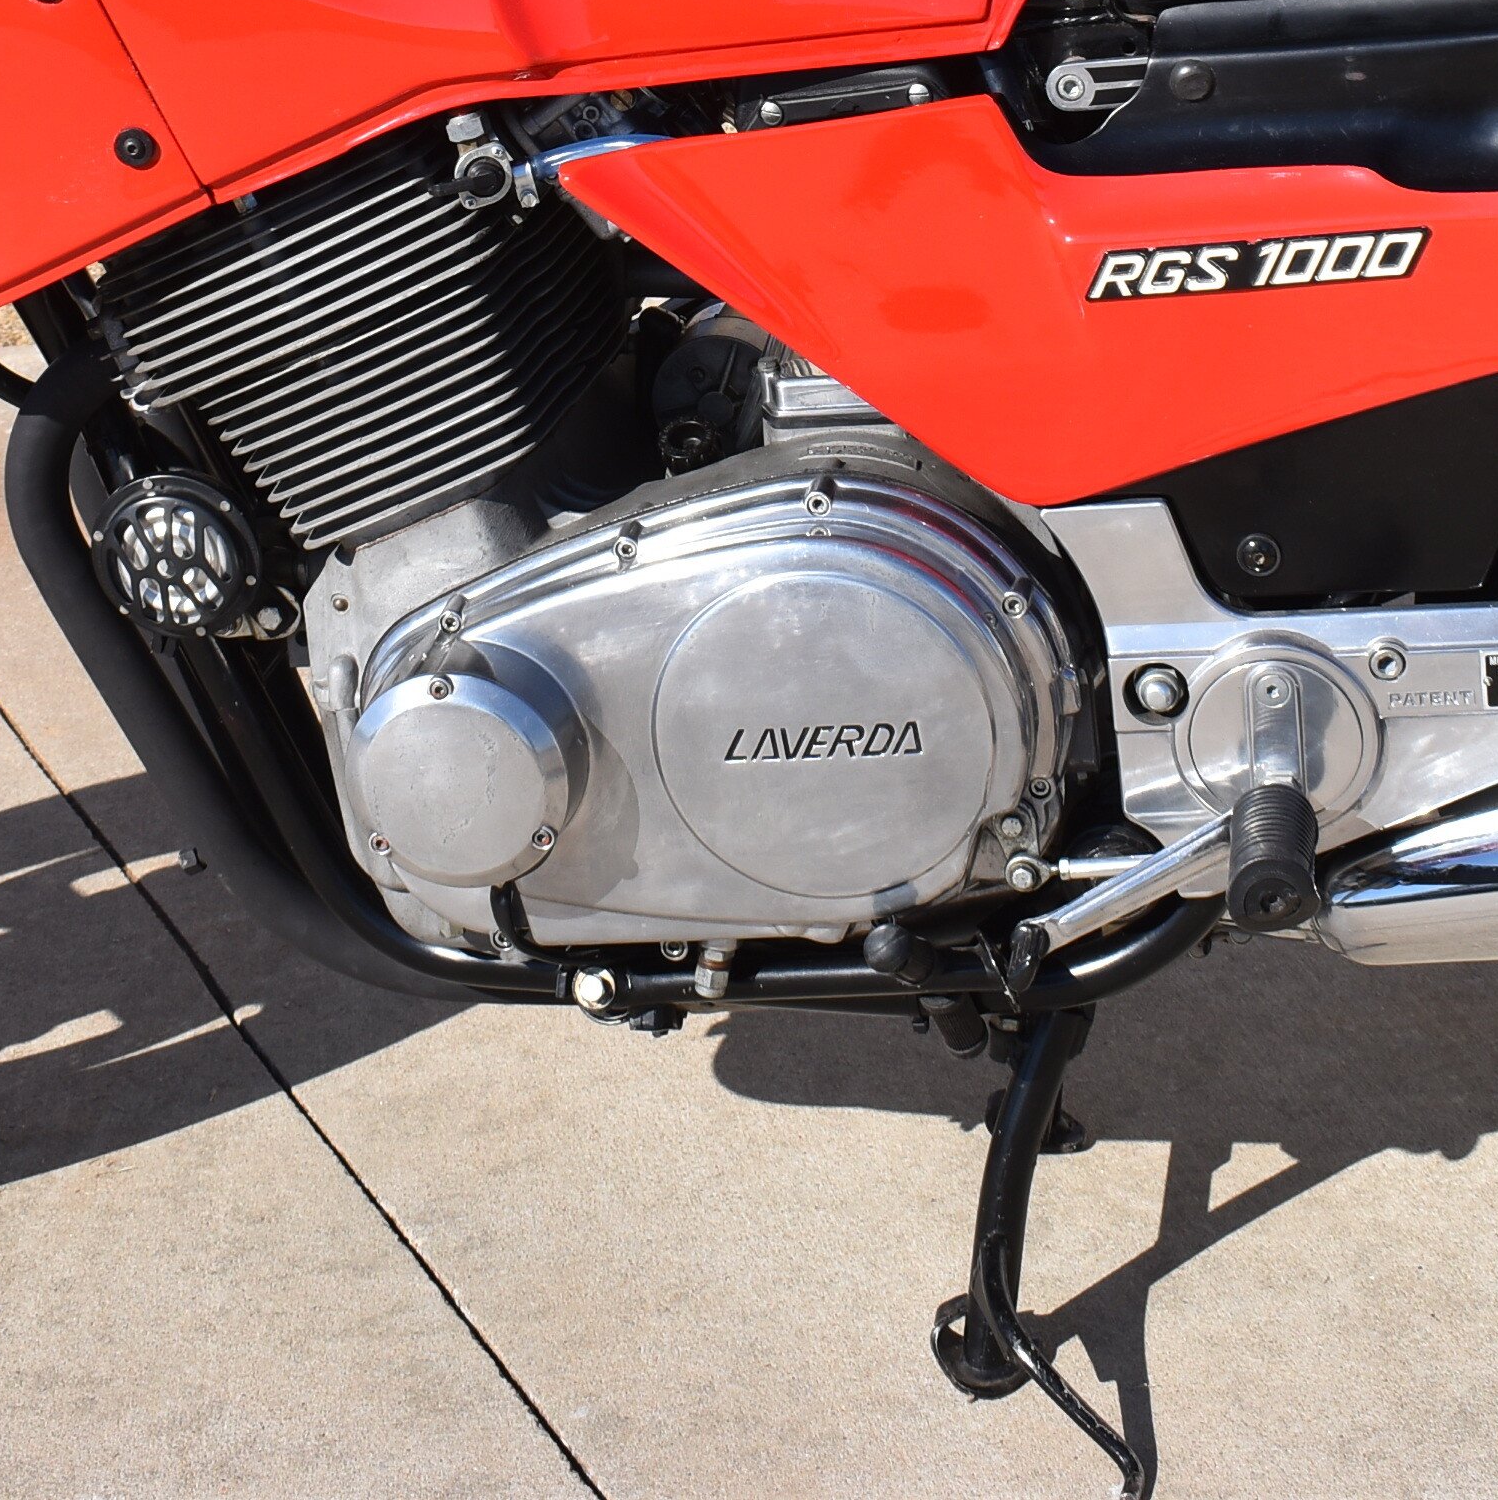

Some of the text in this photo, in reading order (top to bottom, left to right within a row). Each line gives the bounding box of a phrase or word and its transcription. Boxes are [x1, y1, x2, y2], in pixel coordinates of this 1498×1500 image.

[1089, 231, 1425, 300] RGS 1000
[1388, 689, 1473, 709] PATENT
[724, 720, 924, 765] LAVERDA
